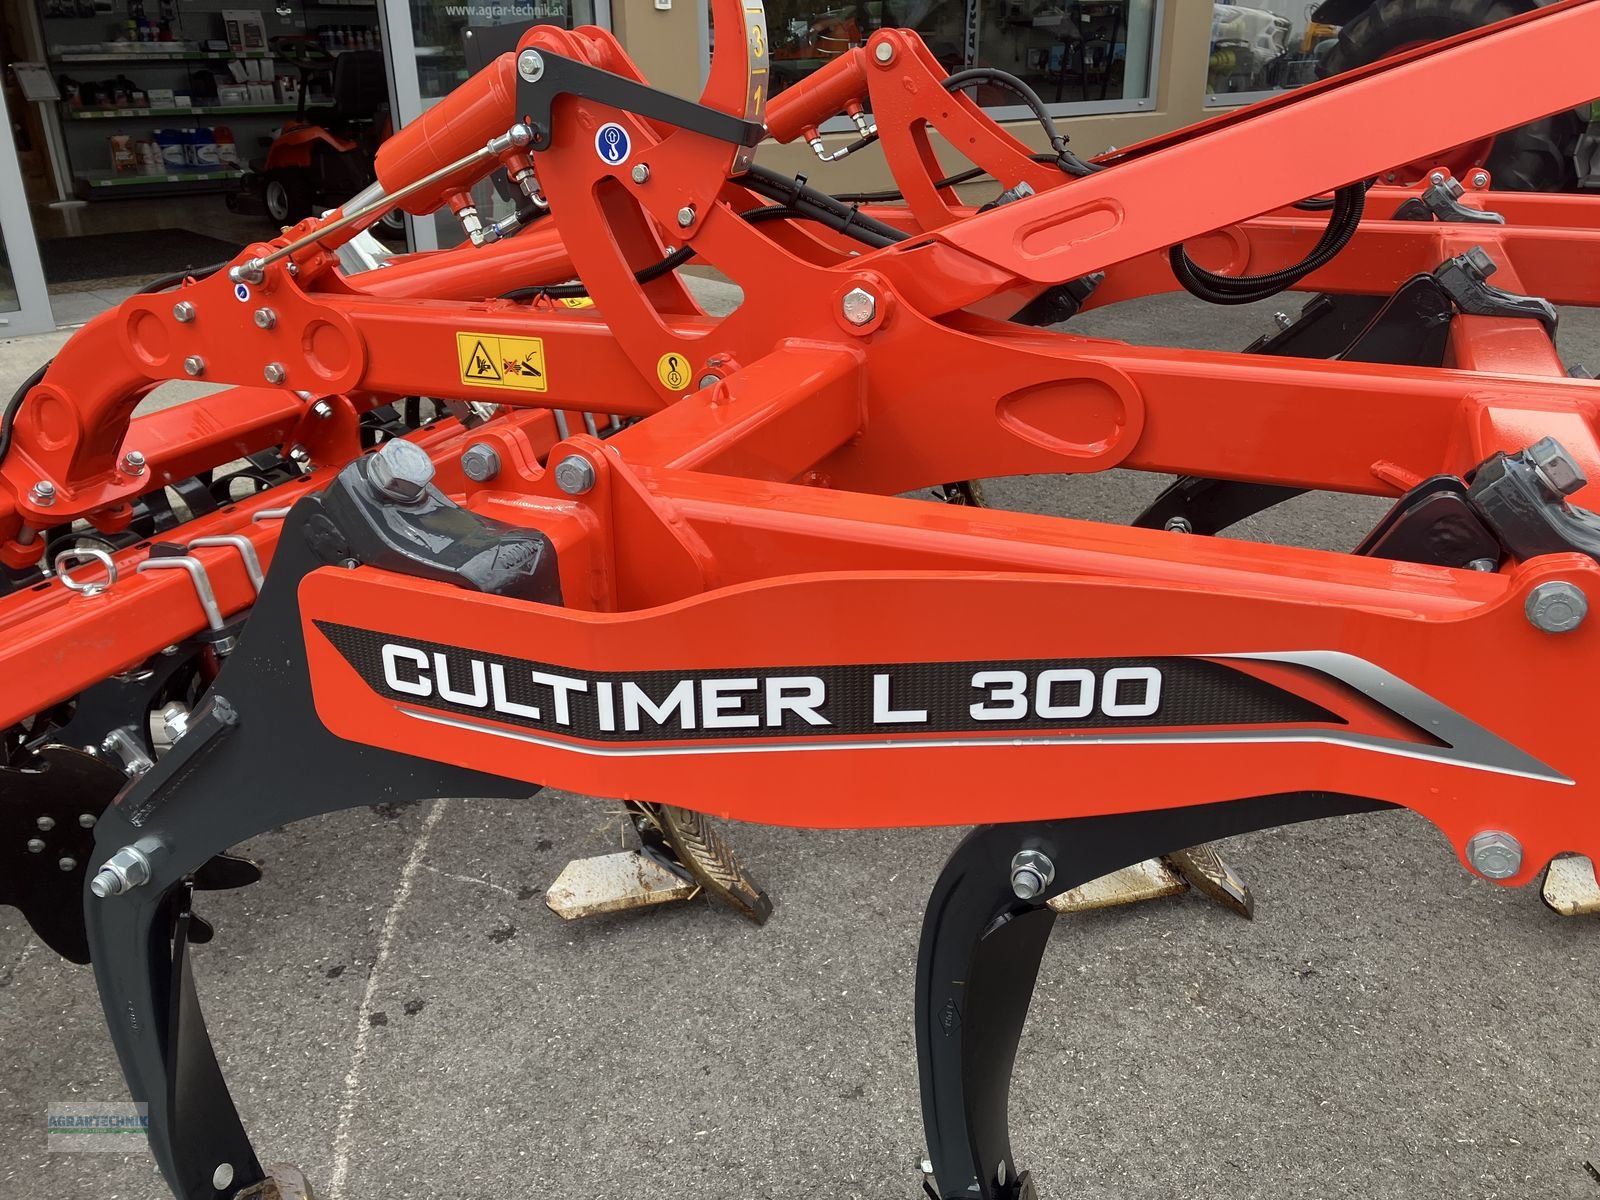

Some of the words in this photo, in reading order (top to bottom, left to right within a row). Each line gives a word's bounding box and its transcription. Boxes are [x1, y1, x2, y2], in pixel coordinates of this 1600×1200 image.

[445, 3, 564, 18] www.agrar-technik.at
[752, 24, 764, 58] 3
[754, 84, 763, 116] 1
[381, 643, 832, 732] CULTIMER
[873, 673, 928, 724] L
[969, 666, 1162, 721] 300
